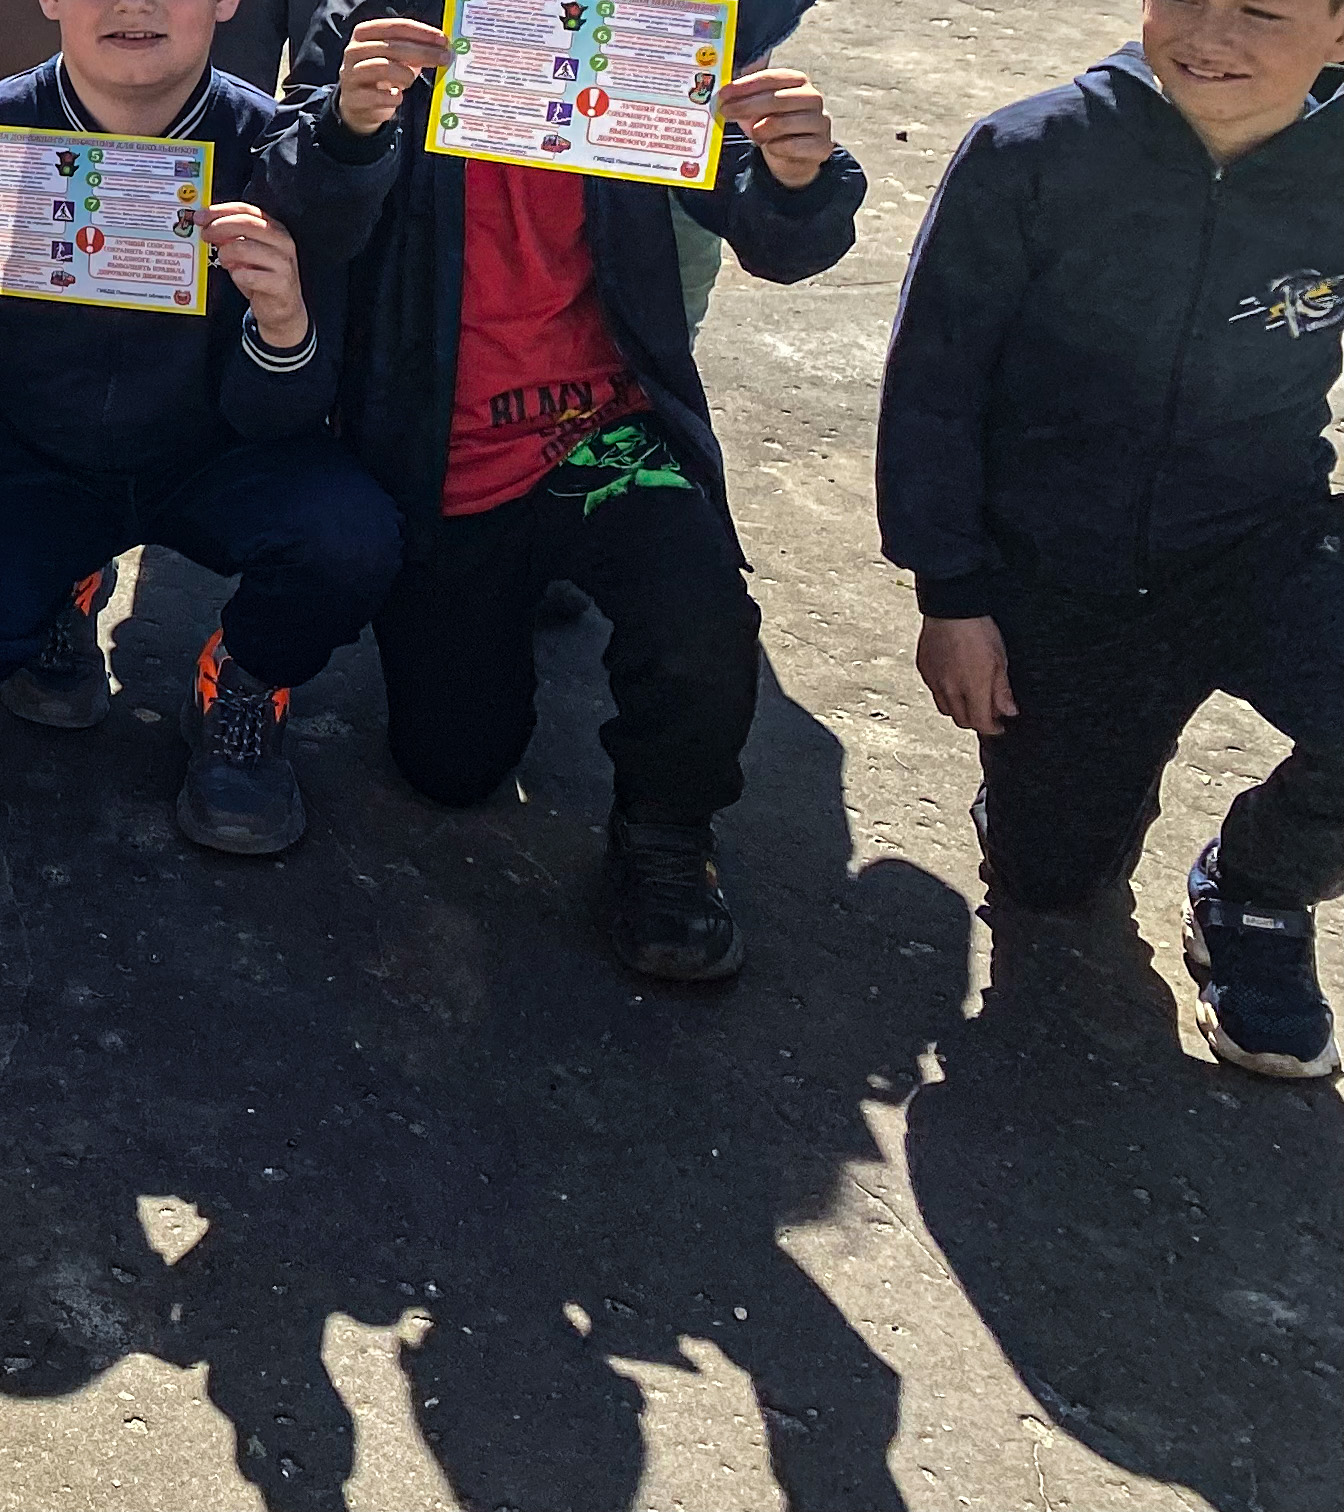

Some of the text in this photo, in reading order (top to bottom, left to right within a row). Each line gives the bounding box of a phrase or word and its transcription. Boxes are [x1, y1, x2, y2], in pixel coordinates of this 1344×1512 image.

[601, 4, 610, 14] 5
[597, 31, 607, 40] 6
[456, 41, 467, 52] 2
[595, 57, 605, 68] 7
[449, 84, 459, 94] 3
[444, 117, 455, 127] 4
[91, 151, 100, 161] 5
[89, 175, 98, 184] 6
[88, 199, 97, 209] 7
